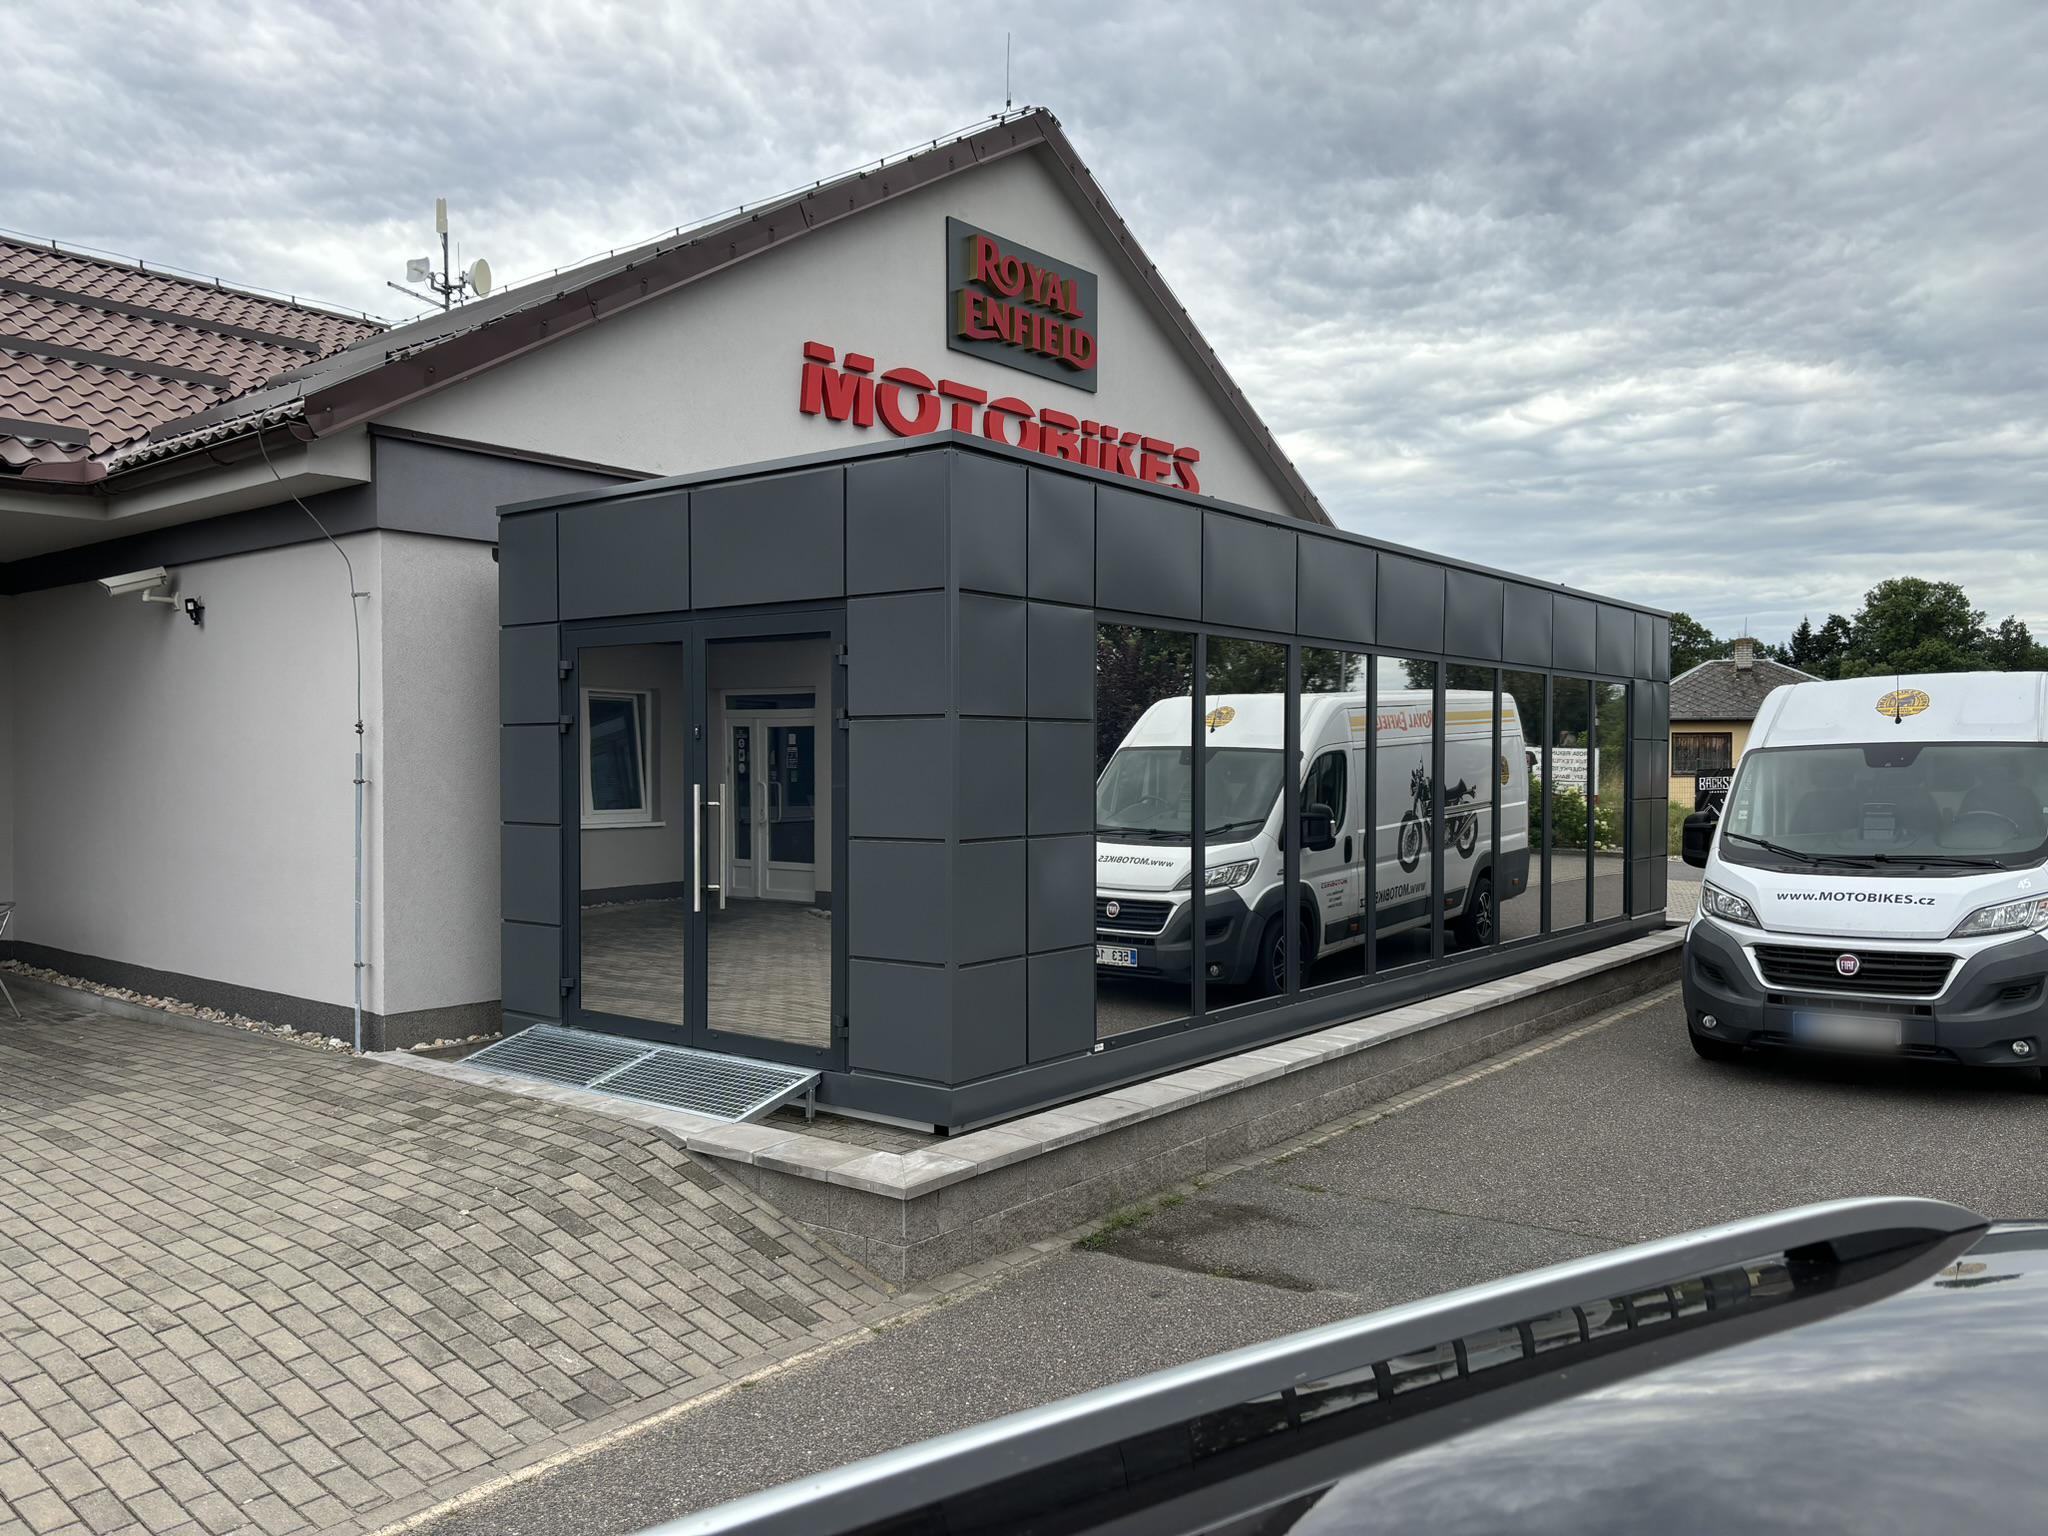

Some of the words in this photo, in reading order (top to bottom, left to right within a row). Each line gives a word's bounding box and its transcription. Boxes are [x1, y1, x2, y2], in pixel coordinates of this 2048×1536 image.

[968, 234, 1084, 320] ROYAL
[957, 289, 1097, 371] ENFIELD
[800, 341, 1201, 494] MOTOBIKES
[1698, 776, 1733, 791] BACKS
[1776, 889, 1936, 906] www.MOTOBIKES.cz
[1840, 960, 1856, 970] FIAT
